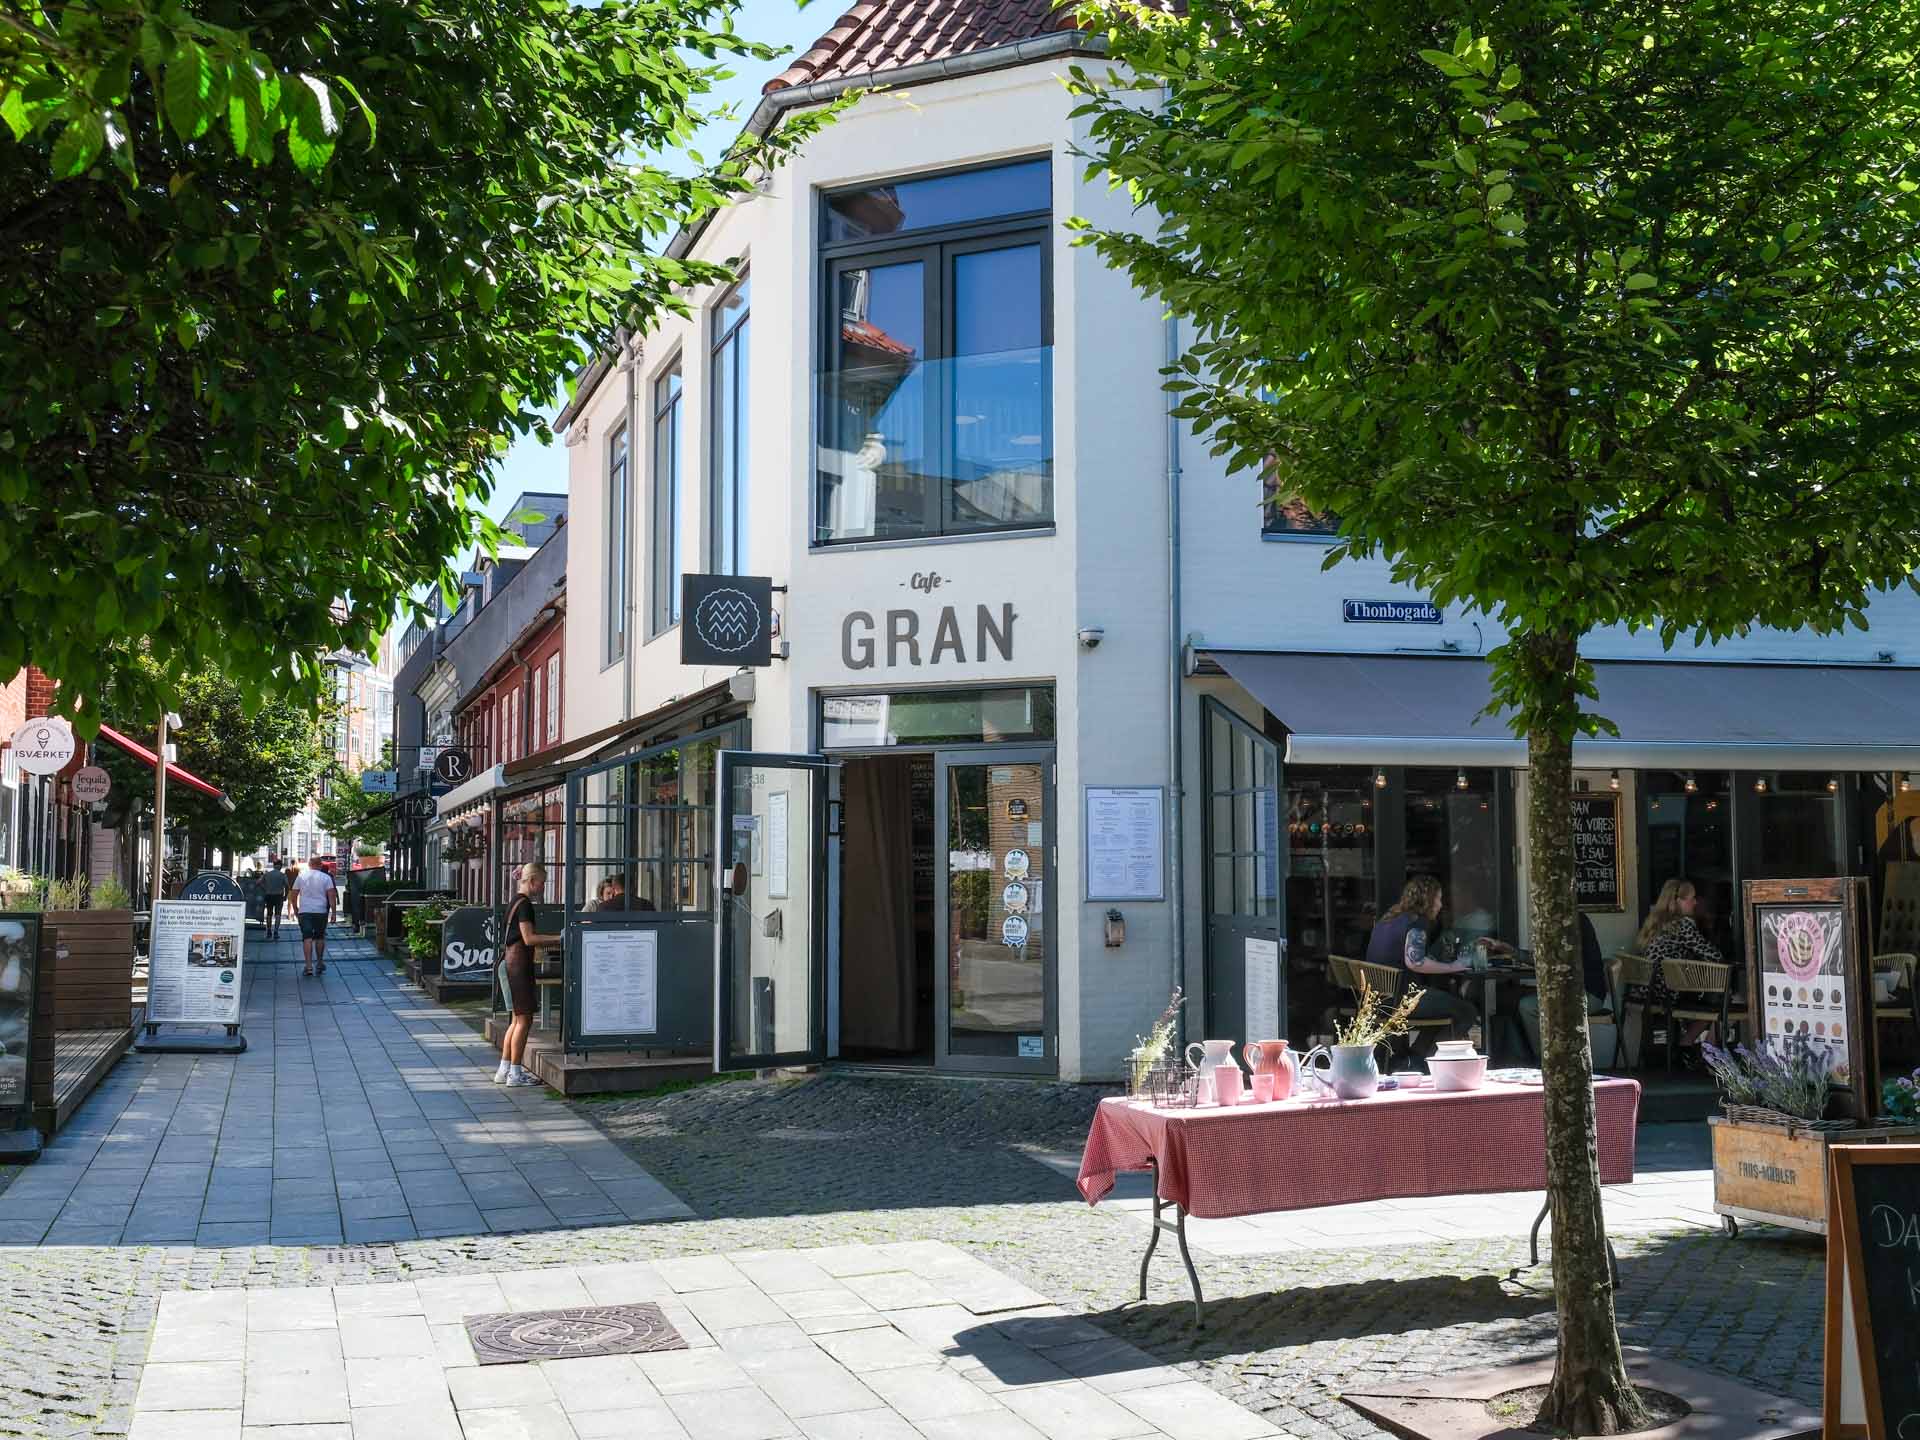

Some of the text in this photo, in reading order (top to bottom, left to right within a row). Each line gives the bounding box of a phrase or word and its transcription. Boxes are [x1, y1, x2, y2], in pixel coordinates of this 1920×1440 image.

[910, 571, 942, 594] Cafe
[1350, 601, 1437, 621] Thonbogade
[841, 602, 1018, 670] GRAN
[15, 750, 71, 759] ISVÆRKET
[447, 755, 463, 777] R
[76, 783, 106, 794] Sunrise
[77, 773, 107, 785] Tequila
[1586, 818, 1616, 833] VORES
[446, 941, 495, 970] Sva
[1871, 1203, 1920, 1250] DA
